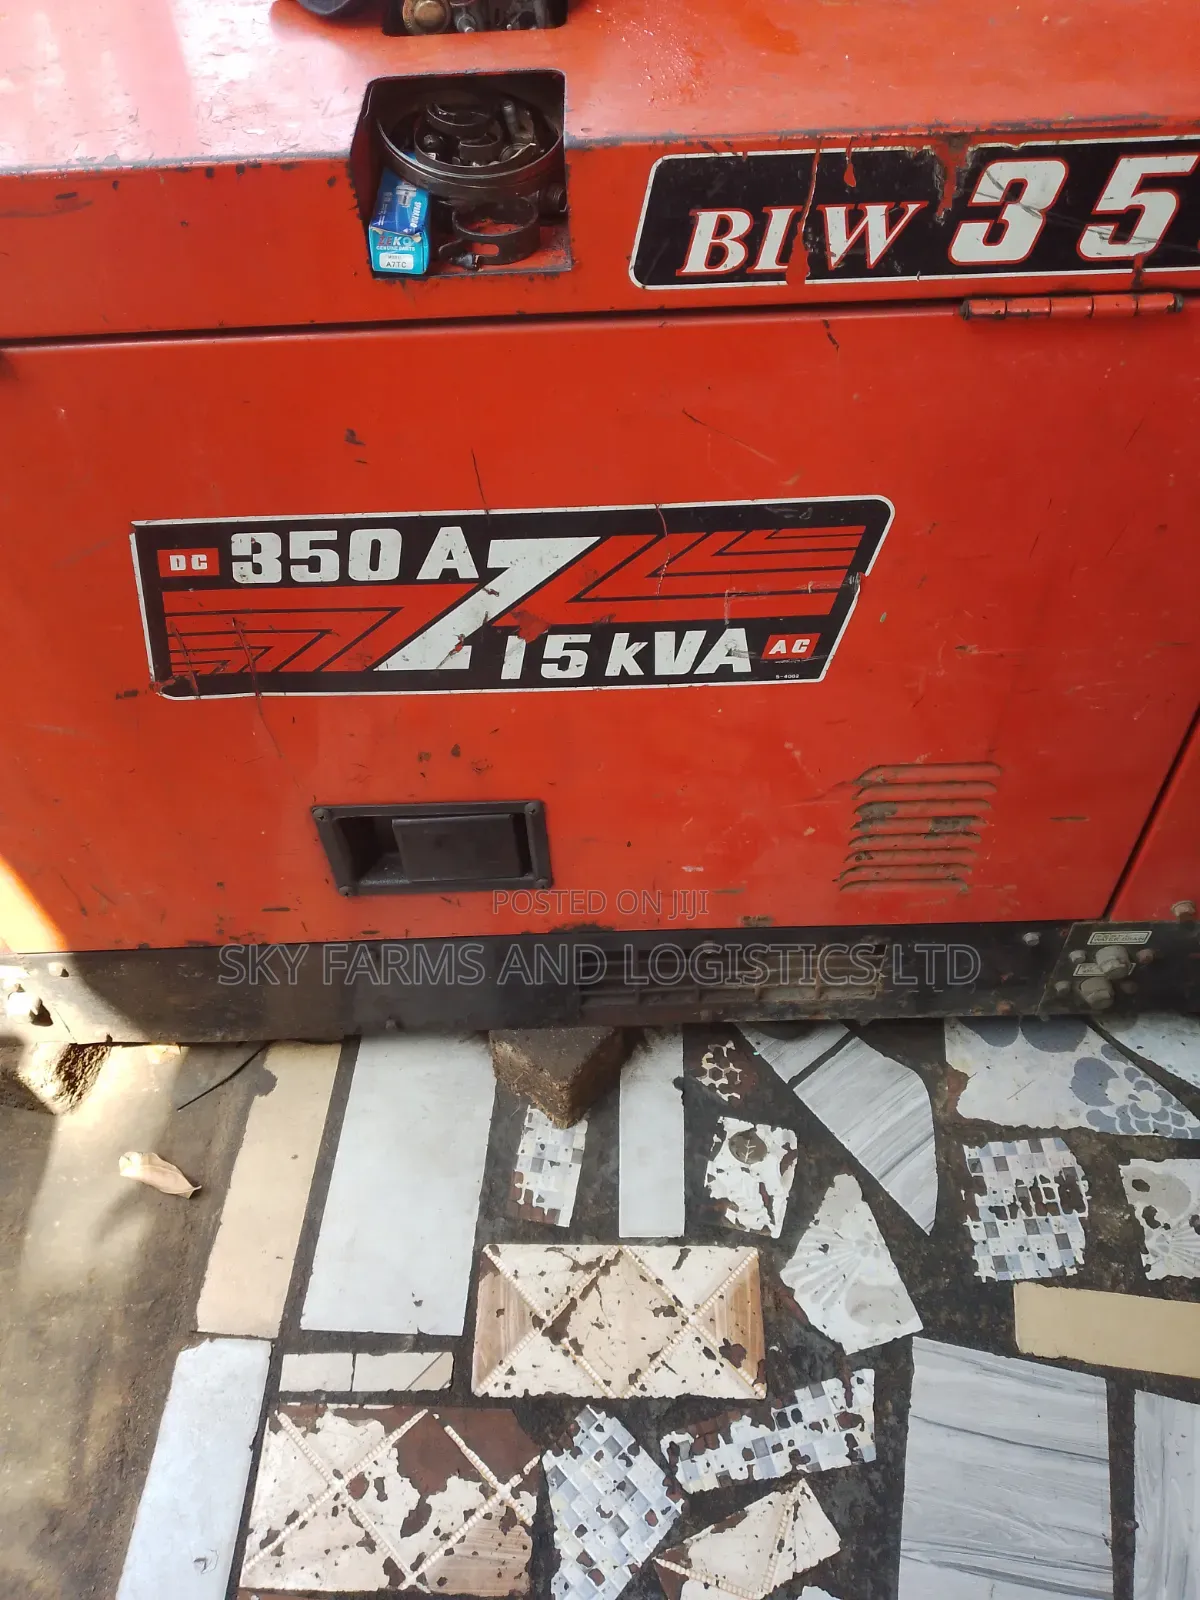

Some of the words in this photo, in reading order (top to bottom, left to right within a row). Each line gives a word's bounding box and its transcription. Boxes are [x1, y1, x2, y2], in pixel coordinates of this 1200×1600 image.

[948, 156, 1200, 266] 35
[169, 554, 208, 571] DC
[231, 528, 402, 584] 350
[416, 526, 479, 580] A
[500, 634, 591, 680] 15
[604, 628, 752, 677] kVA
[768, 639, 811, 655] AC
